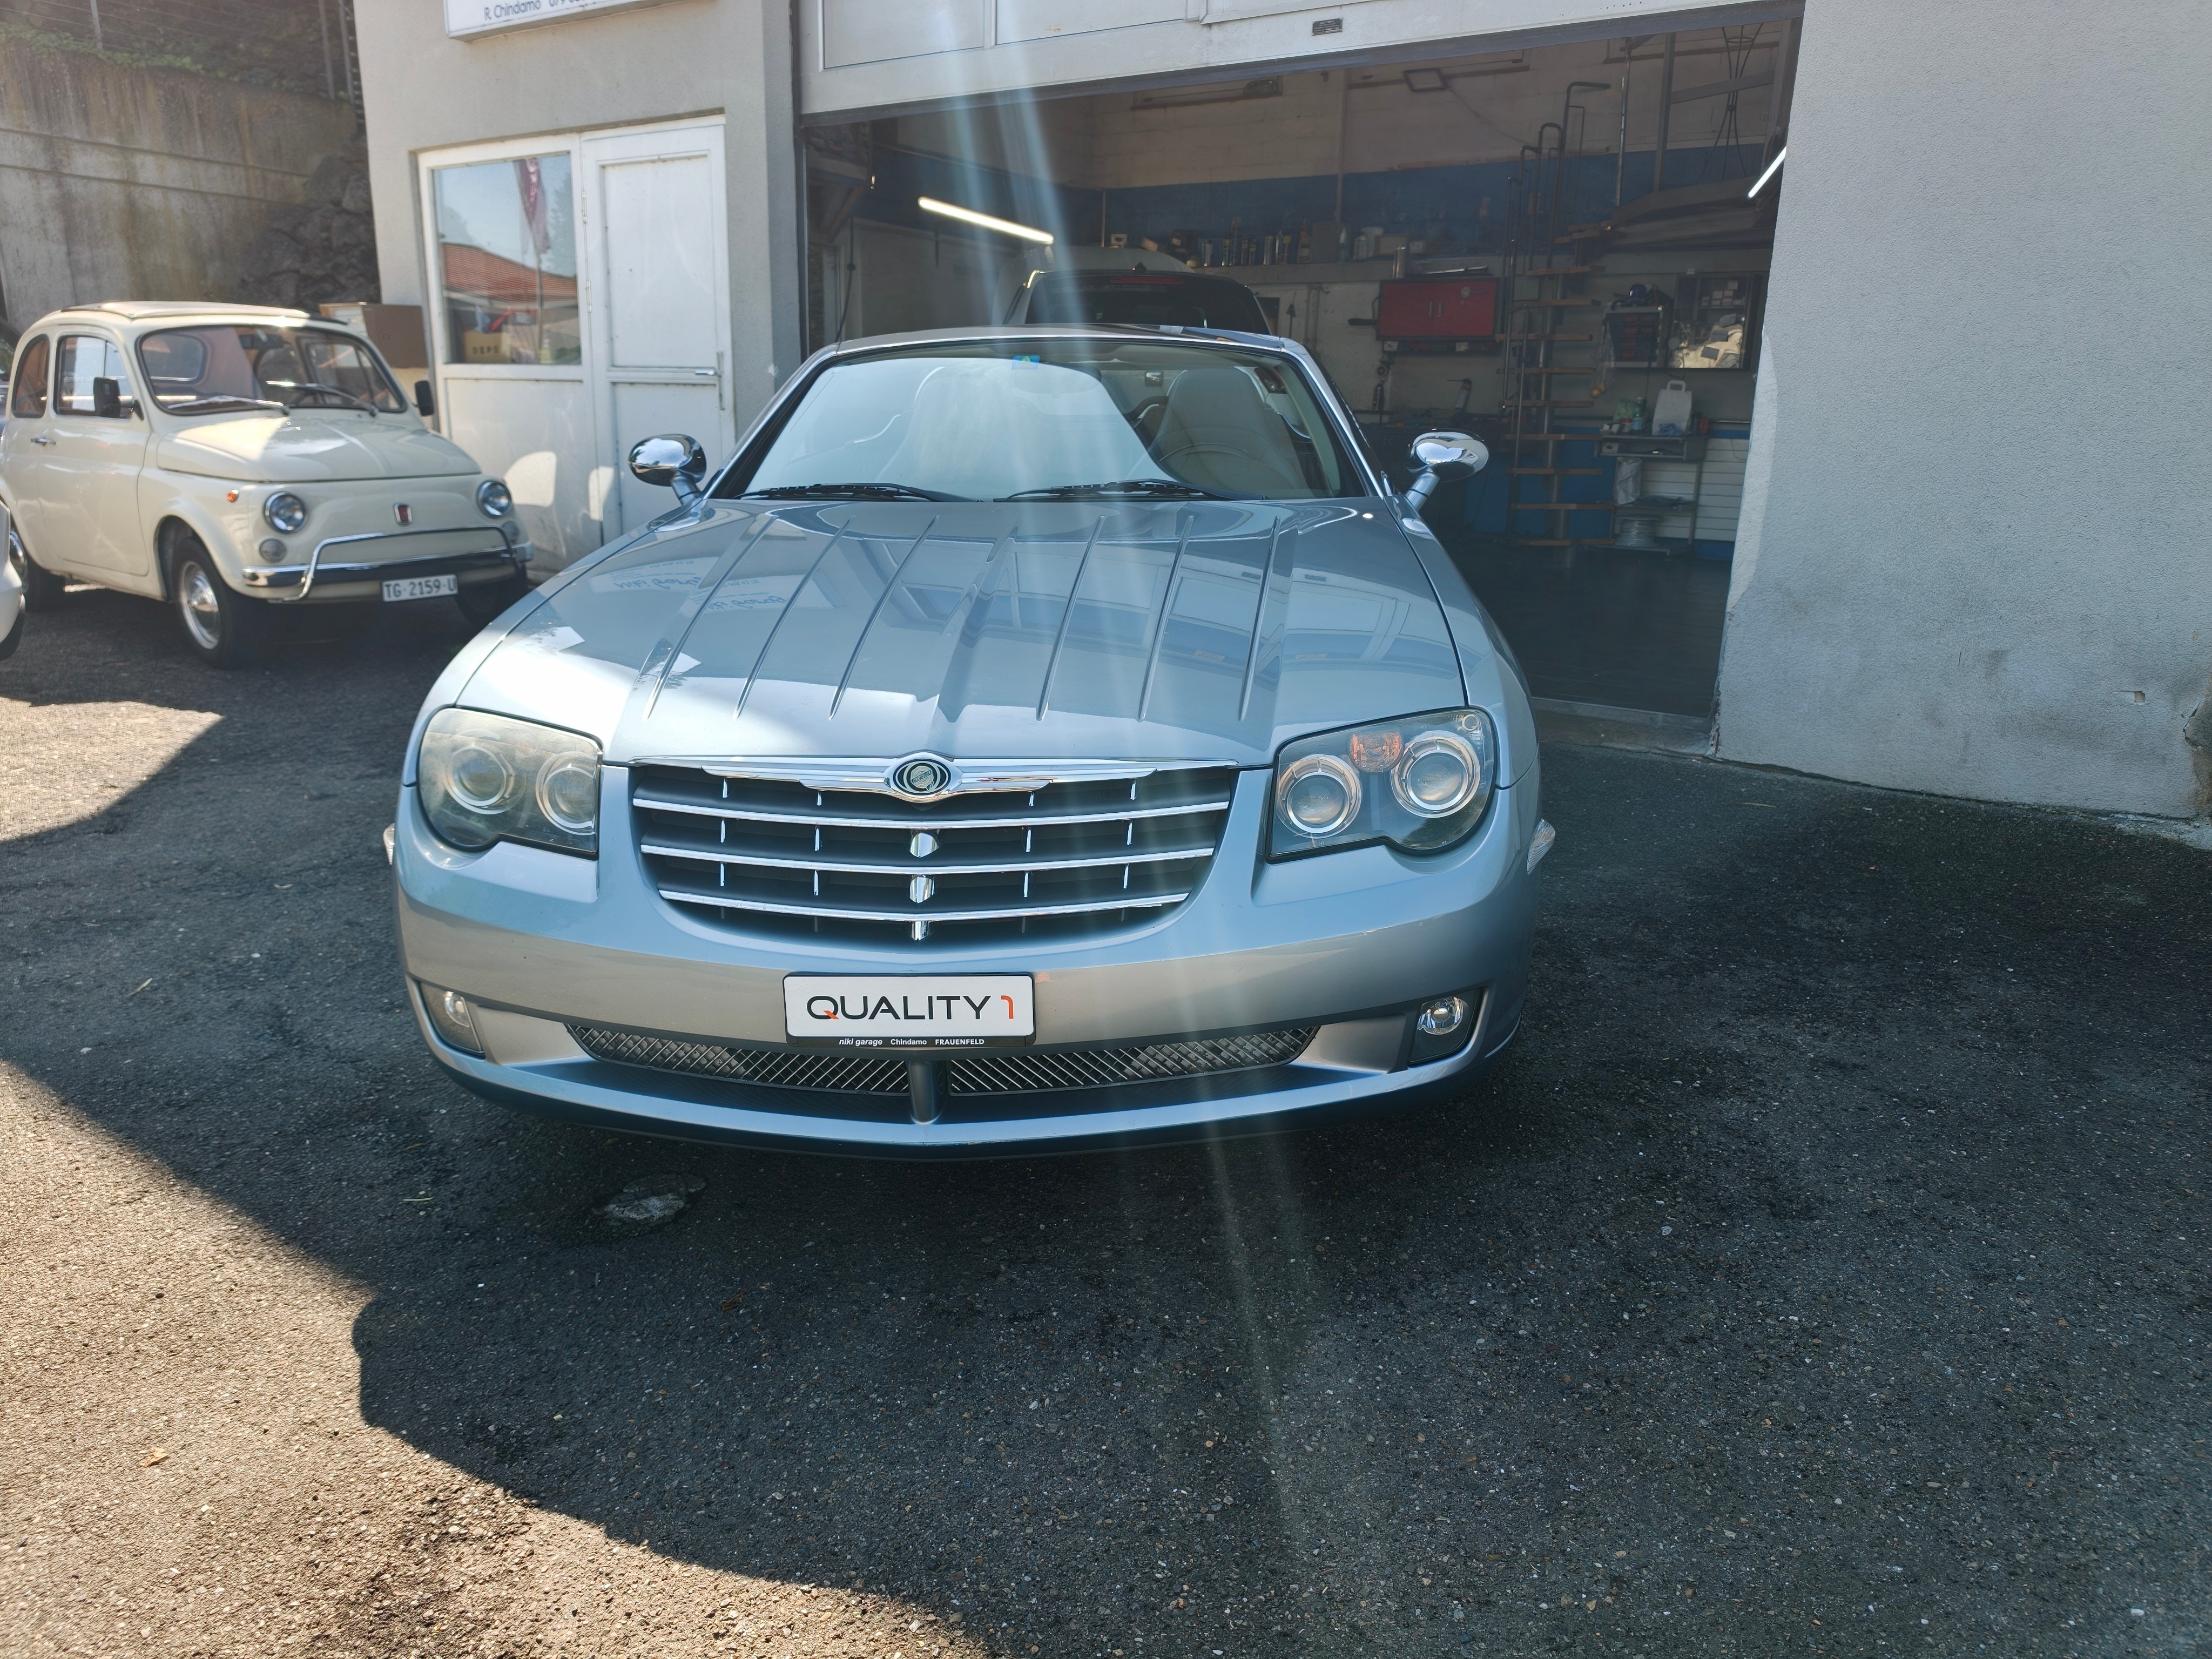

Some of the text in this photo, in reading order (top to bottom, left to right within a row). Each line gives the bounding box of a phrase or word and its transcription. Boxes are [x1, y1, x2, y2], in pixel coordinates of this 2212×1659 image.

[494, 0, 542, 18] Chindamo
[385, 583, 402, 598] TG
[409, 578, 441, 597] 2159
[806, 995, 1015, 1020] QUALITY 1
